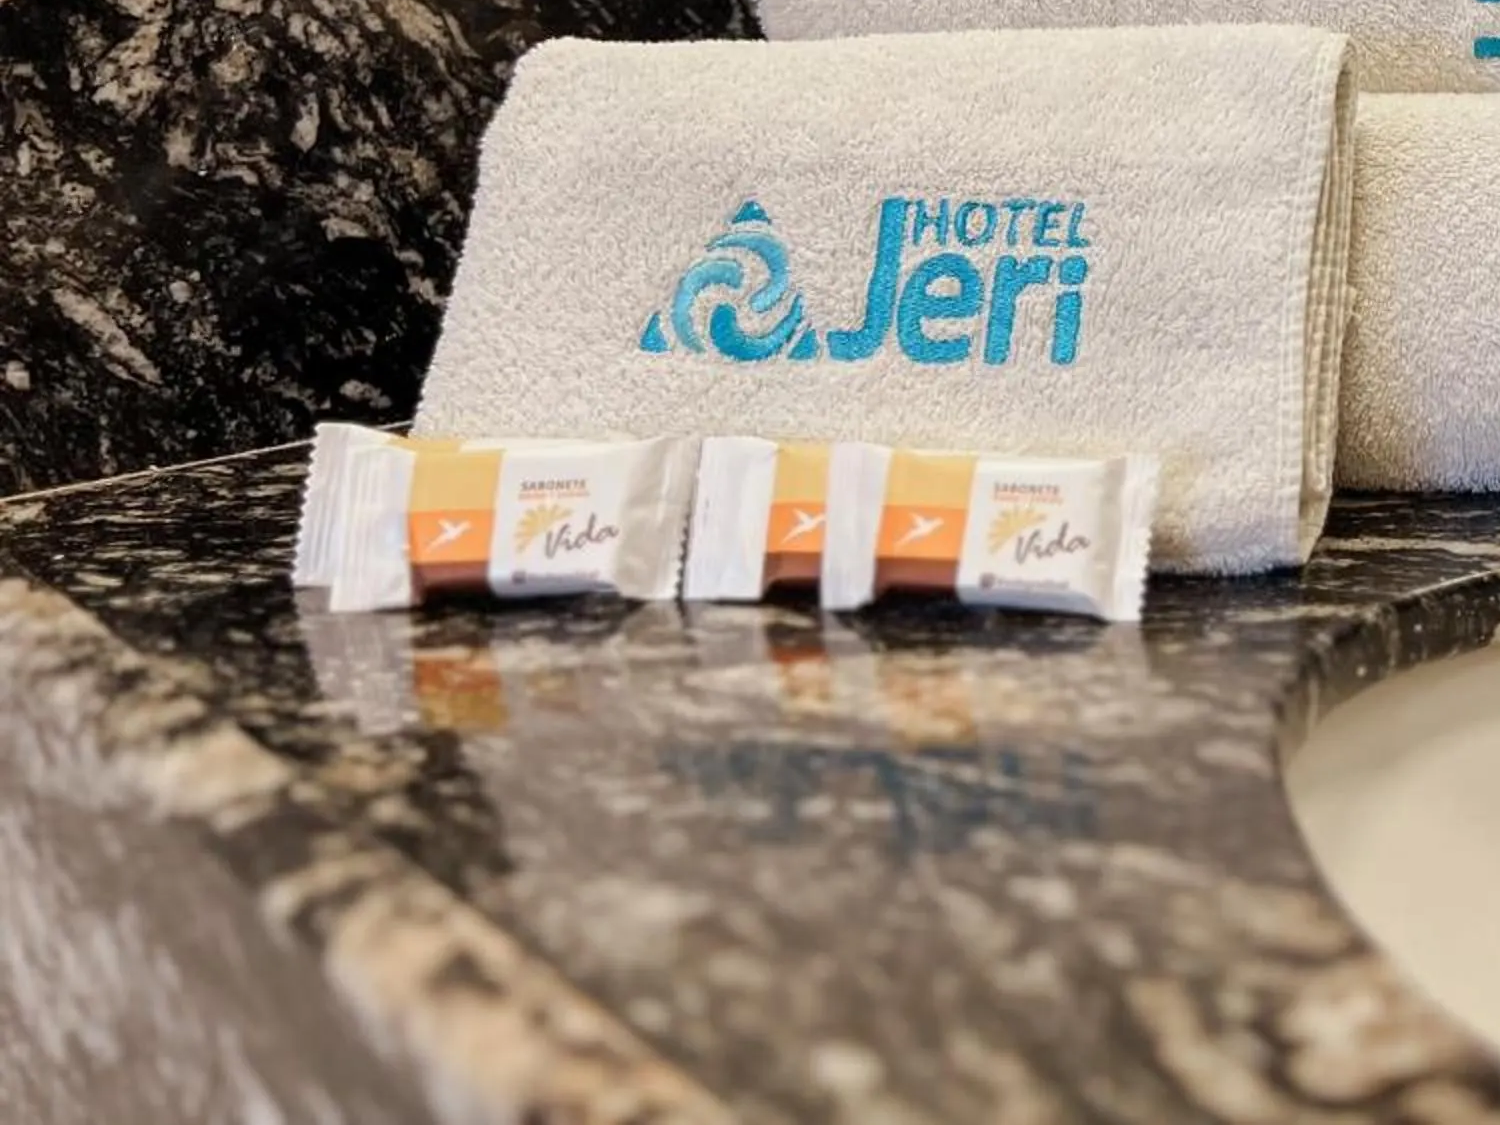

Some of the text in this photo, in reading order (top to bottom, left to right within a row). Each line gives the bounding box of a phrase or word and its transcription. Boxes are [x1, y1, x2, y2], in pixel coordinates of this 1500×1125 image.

[912, 198, 1090, 248] HOTEL
[825, 195, 1090, 365] Jeri
[544, 512, 620, 560] Vida
[1014, 520, 1091, 565] Vida
